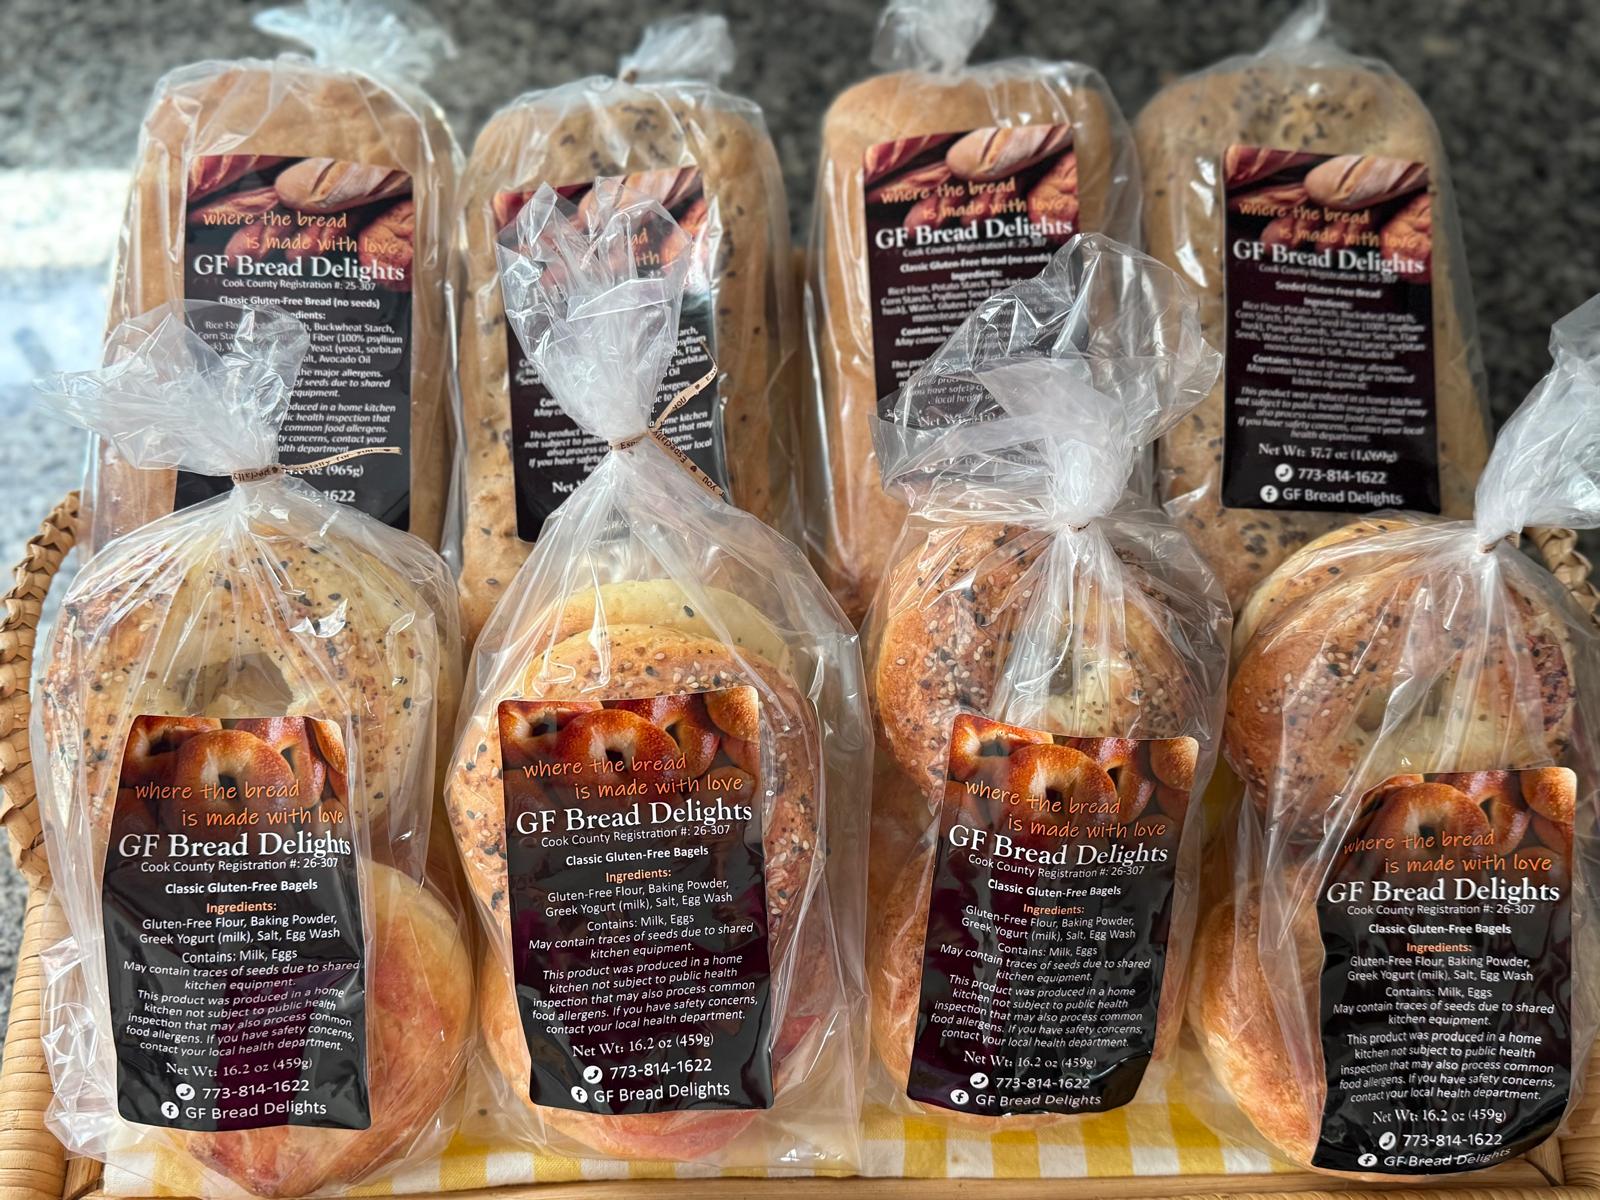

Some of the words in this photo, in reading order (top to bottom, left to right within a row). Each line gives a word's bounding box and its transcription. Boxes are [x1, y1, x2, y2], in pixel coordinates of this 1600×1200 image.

[880, 184, 931, 204] where
[937, 183, 963, 198] the
[968, 177, 1015, 197] bread
[922, 206, 936, 220] is
[941, 205, 983, 218] made
[989, 198, 1026, 215] with
[1031, 196, 1066, 211] love
[1239, 202, 1287, 218] where
[1292, 206, 1319, 221] the
[1324, 206, 1370, 224] bread
[203, 211, 254, 228] where
[261, 211, 291, 226] the
[297, 211, 347, 229] bread
[876, 228, 909, 249] GF
[916, 224, 978, 246] Bread
[986, 216, 1073, 239] Delights
[1280, 228, 1293, 240] is
[1296, 226, 1339, 243] made
[1344, 231, 1379, 248] with
[1384, 231, 1418, 248] love
[246, 234, 260, 249] is
[266, 234, 311, 250] made
[317, 236, 358, 253] with
[364, 237, 399, 255] love
[1233, 239, 1266, 260] GF
[1272, 244, 1331, 268] Bread
[1339, 250, 1425, 275] Delights
[194, 256, 229, 277] GF
[236, 256, 302, 277] Bread
[311, 256, 405, 282] Delights
[222, 279, 244, 288] Cook
[246, 279, 278, 291] County
[279, 279, 332, 292] Registration
[334, 280, 343, 291] #:
[345, 281, 376, 292] 25-307
[219, 296, 249, 306] Classic
[250, 295, 303, 307] Gluten-Free
[304, 296, 332, 308] Bread
[333, 297, 348, 309] (no
[350, 298, 380, 309] seeds)
[326, 464, 364, 478] (965g)
[1298, 468, 1387, 484] 773-814-1622
[1282, 488, 1302, 501] GF
[1304, 489, 1344, 502] Bread
[1348, 490, 1402, 506] Delights
[522, 758, 583, 778] where
[589, 756, 626, 775] the
[631, 752, 687, 772] bread
[135, 783, 193, 800] where
[200, 783, 238, 800] the
[244, 779, 300, 800] bread
[574, 784, 591, 800] is
[598, 782, 648, 799] made
[655, 779, 701, 796] with
[706, 776, 744, 792] love
[181, 809, 199, 827] is
[205, 807, 259, 827] made
[266, 805, 313, 824] with
[317, 805, 345, 824] love
[516, 811, 556, 835] GF
[566, 804, 642, 832] Bread
[651, 798, 753, 826] Delights
[119, 833, 162, 858] GF
[168, 833, 249, 857] Bread
[258, 831, 352, 857] Delights
[948, 825, 988, 851] GF
[993, 832, 1067, 866] Bread
[1077, 843, 1168, 868] Delights
[1343, 835, 1395, 855] where
[1401, 833, 1434, 850] the
[1441, 830, 1496, 848] bread
[140, 860, 171, 873] Cook
[173, 860, 215, 874] County
[218, 858, 287, 873] Registration
[288, 858, 301, 870] #:
[303, 857, 339, 869] 26-307
[1384, 857, 1399, 874] is
[1406, 856, 1456, 873] made
[1462, 853, 1507, 872] with
[1512, 853, 1553, 872] love
[605, 866, 672, 883] Ingredients:
[165, 882, 205, 895] Classic
[207, 880, 278, 894] Gluten-Free
[280, 879, 318, 893] Bagels
[547, 887, 613, 905] Gluten-Free
[615, 885, 646, 900] Flour,
[648, 881, 685, 898] Baking
[687, 877, 730, 894] Powder,
[987, 878, 1024, 895] Classic
[1026, 885, 1088, 899] Gluten-Free
[1090, 885, 1121, 899] Bagels
[1326, 881, 1364, 905] GF
[1372, 880, 1445, 902] Bread
[1454, 877, 1560, 904] Delights
[545, 902, 575, 918] Greek
[577, 902, 616, 916] Yogurt
[618, 897, 653, 914] (milk),
[655, 895, 679, 910] Salt,
[681, 894, 702, 910] Egg
[703, 892, 733, 904] Wash
[1346, 904, 1373, 916] Cook
[1375, 904, 1414, 918] County
[1417, 903, 1480, 917] Registration
[1483, 903, 1494, 914] #:
[1496, 903, 1535, 914] 26-307
[587, 918, 638, 932] Contains:
[640, 915, 668, 930] Milk,
[670, 912, 695, 928] Eggs
[529, 938, 553, 952] May
[554, 934, 596, 948] contain
[598, 932, 631, 947] traces
[633, 930, 645, 943] of
[646, 928, 679, 943] seeds
[681, 926, 701, 940] due
[703, 925, 716, 937] to
[717, 923, 754, 936] shared
[949, 974, 969, 988] This
[971, 981, 1012, 996] product
[1015, 986, 1034, 997] was
[1036, 985, 1083, 998] produced
[1086, 986, 1096, 997] in
[1098, 988, 1104, 997] a
[1106, 985, 1135, 997] home
[952, 990, 990, 1004] kitchen
[992, 996, 1010, 1007] not
[1012, 996, 1050, 1011] subject
[1052, 996, 1062, 1010] to
[1065, 998, 1095, 1010] public
[1097, 997, 1128, 1010] health
[165, 1062, 189, 1077] Net
[191, 1062, 218, 1078] Wt:
[222, 1062, 251, 1077] 16.2
[253, 1062, 270, 1074] oz
[272, 1058, 313, 1072] (459g)
[609, 1057, 712, 1081] 773-814-1622
[202, 1080, 310, 1099] 773-814-1622
[995, 1076, 1091, 1090] 773-814-1622
[975, 1093, 996, 1107] GF
[1000, 1093, 1042, 1107] Bread
[1044, 1091, 1102, 1108] Delights
[185, 1105, 207, 1120] GF
[211, 1104, 259, 1120] Bread
[262, 1101, 327, 1117] Delights
[1403, 1132, 1502, 1147] 773-814-1622
[1384, 1154, 1407, 1167] GF
[1408, 1153, 1451, 1167] Bread
[1454, 1147, 1511, 1166] Delights
